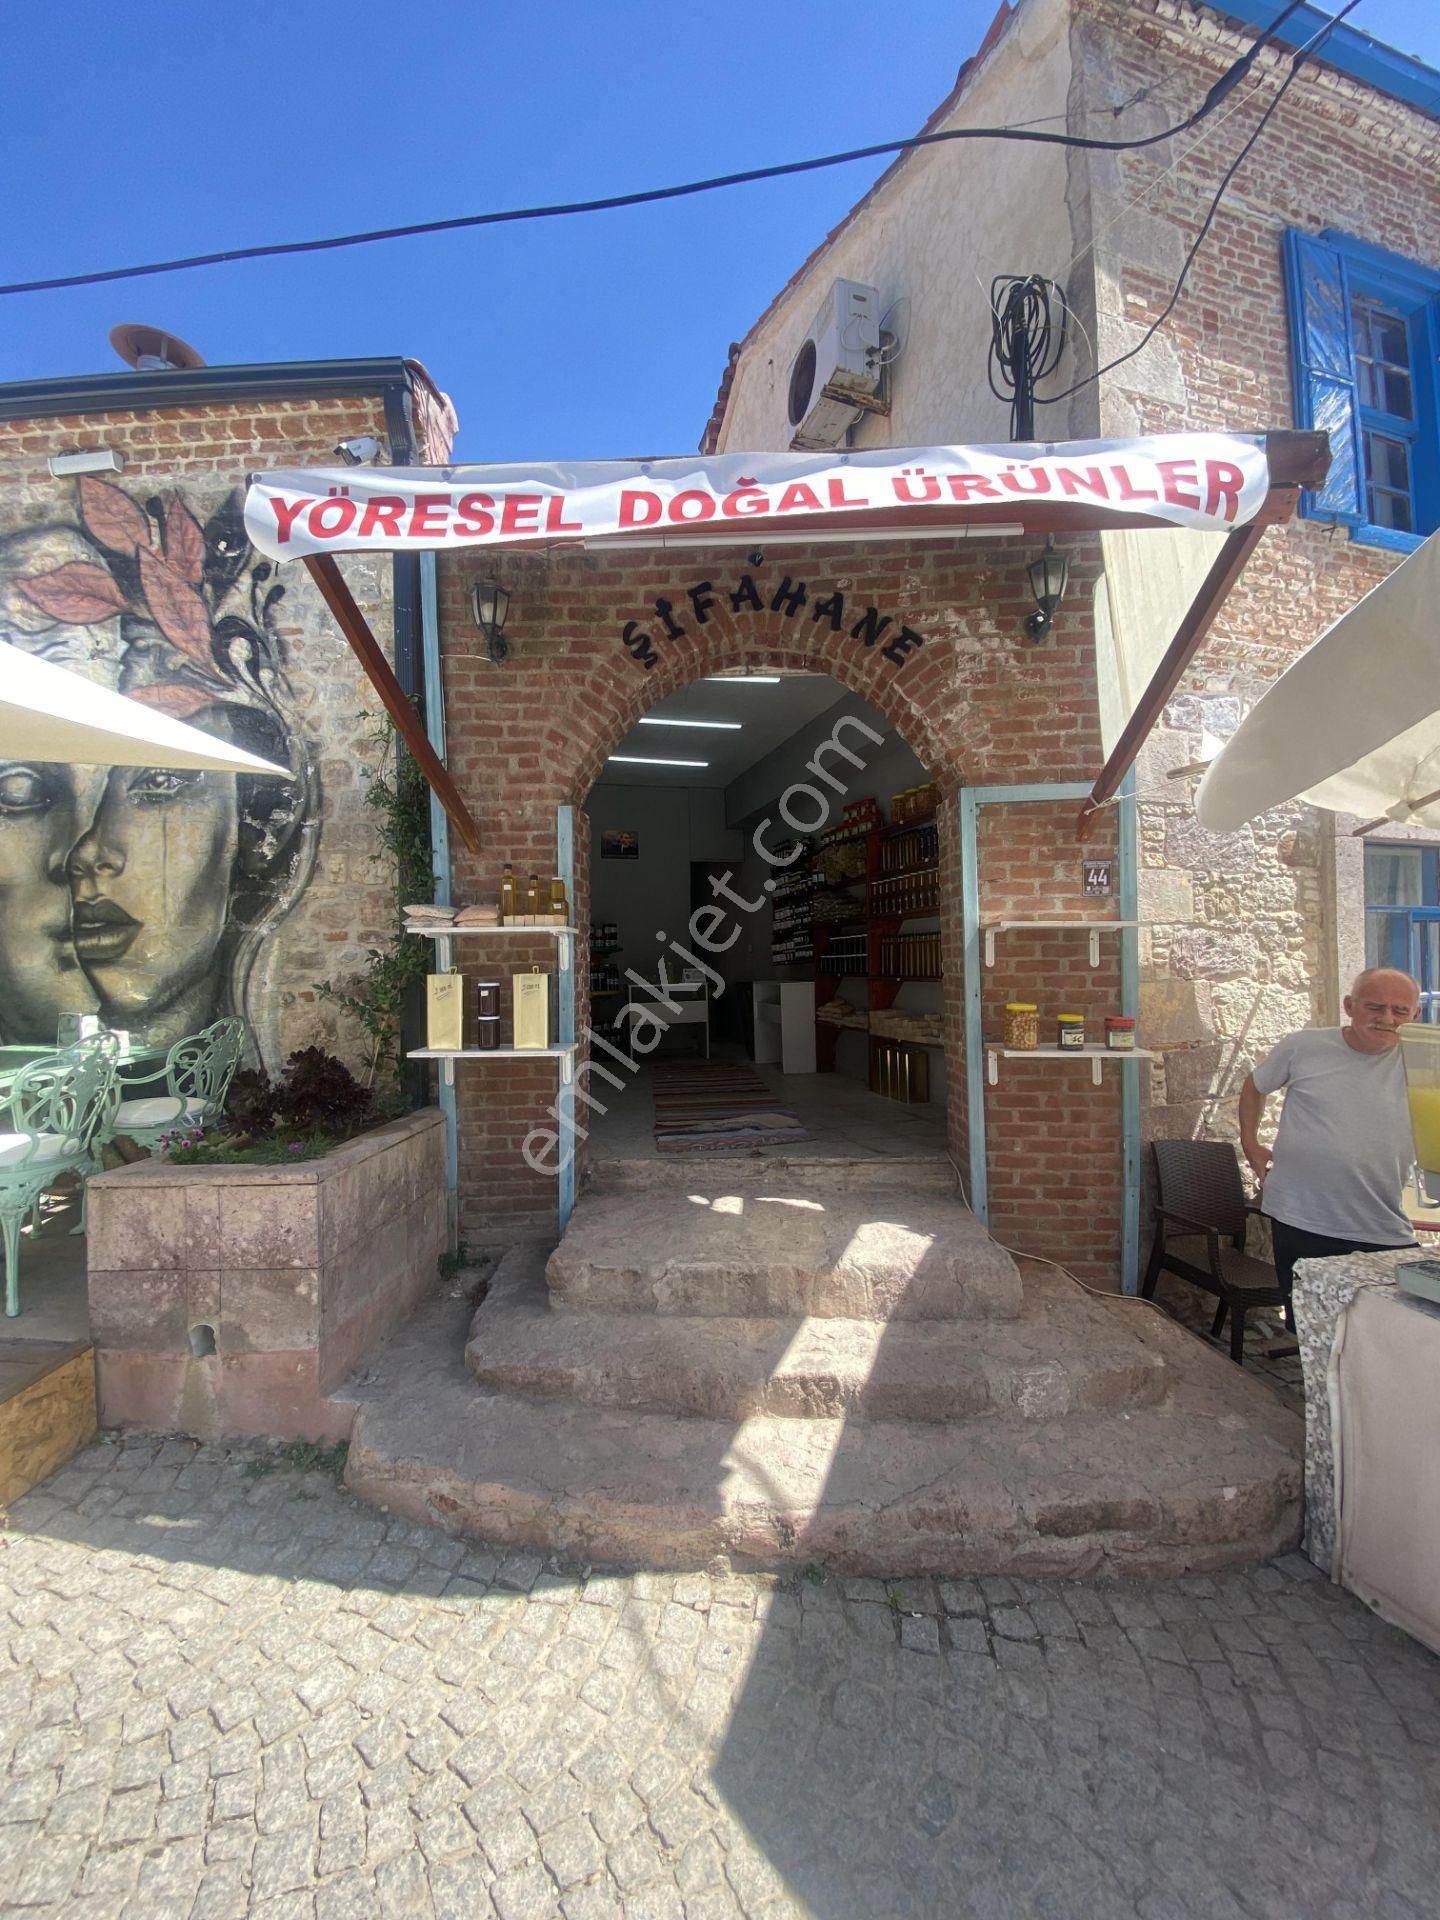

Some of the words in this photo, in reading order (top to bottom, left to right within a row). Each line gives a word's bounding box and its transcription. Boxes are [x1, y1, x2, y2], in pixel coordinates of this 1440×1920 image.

[269, 486, 583, 544] YÖRESEL
[618, 475, 868, 529] DOĞAL
[890, 460, 1247, 522] ÜRÜNLER
[1088, 868, 1107, 885] 44
